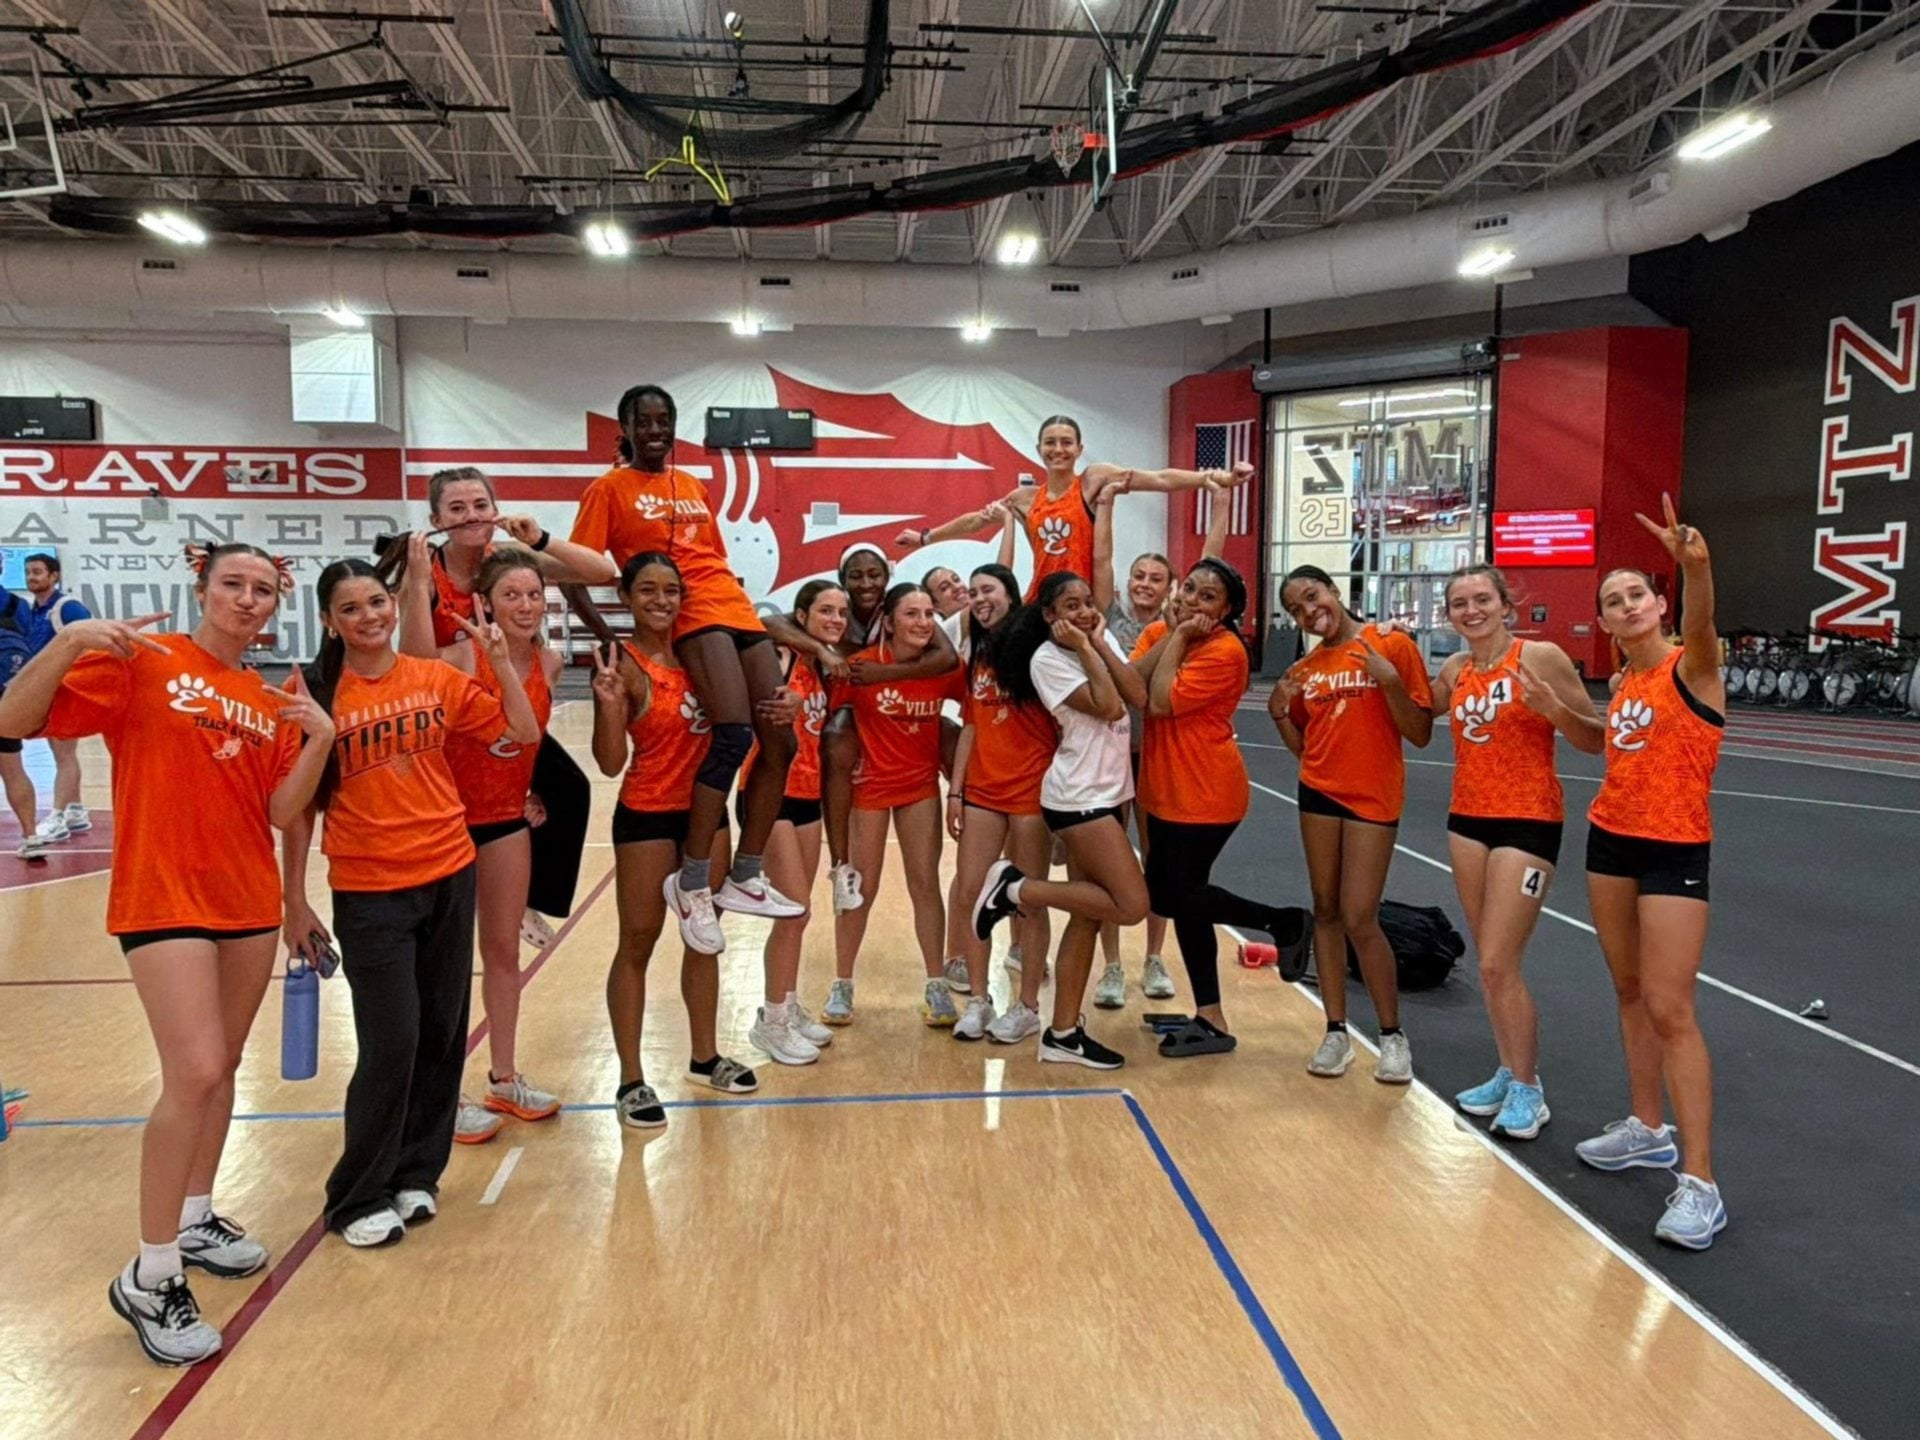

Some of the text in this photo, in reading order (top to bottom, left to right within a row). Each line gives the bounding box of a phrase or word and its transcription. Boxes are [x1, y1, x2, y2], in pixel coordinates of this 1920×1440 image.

[0, 449, 367, 495] RAVES
[0, 512, 399, 545] ARNED
[1491, 681, 1506, 701] 4
[337, 707, 445, 776] TIGERS
[1525, 871, 1541, 895] 4
